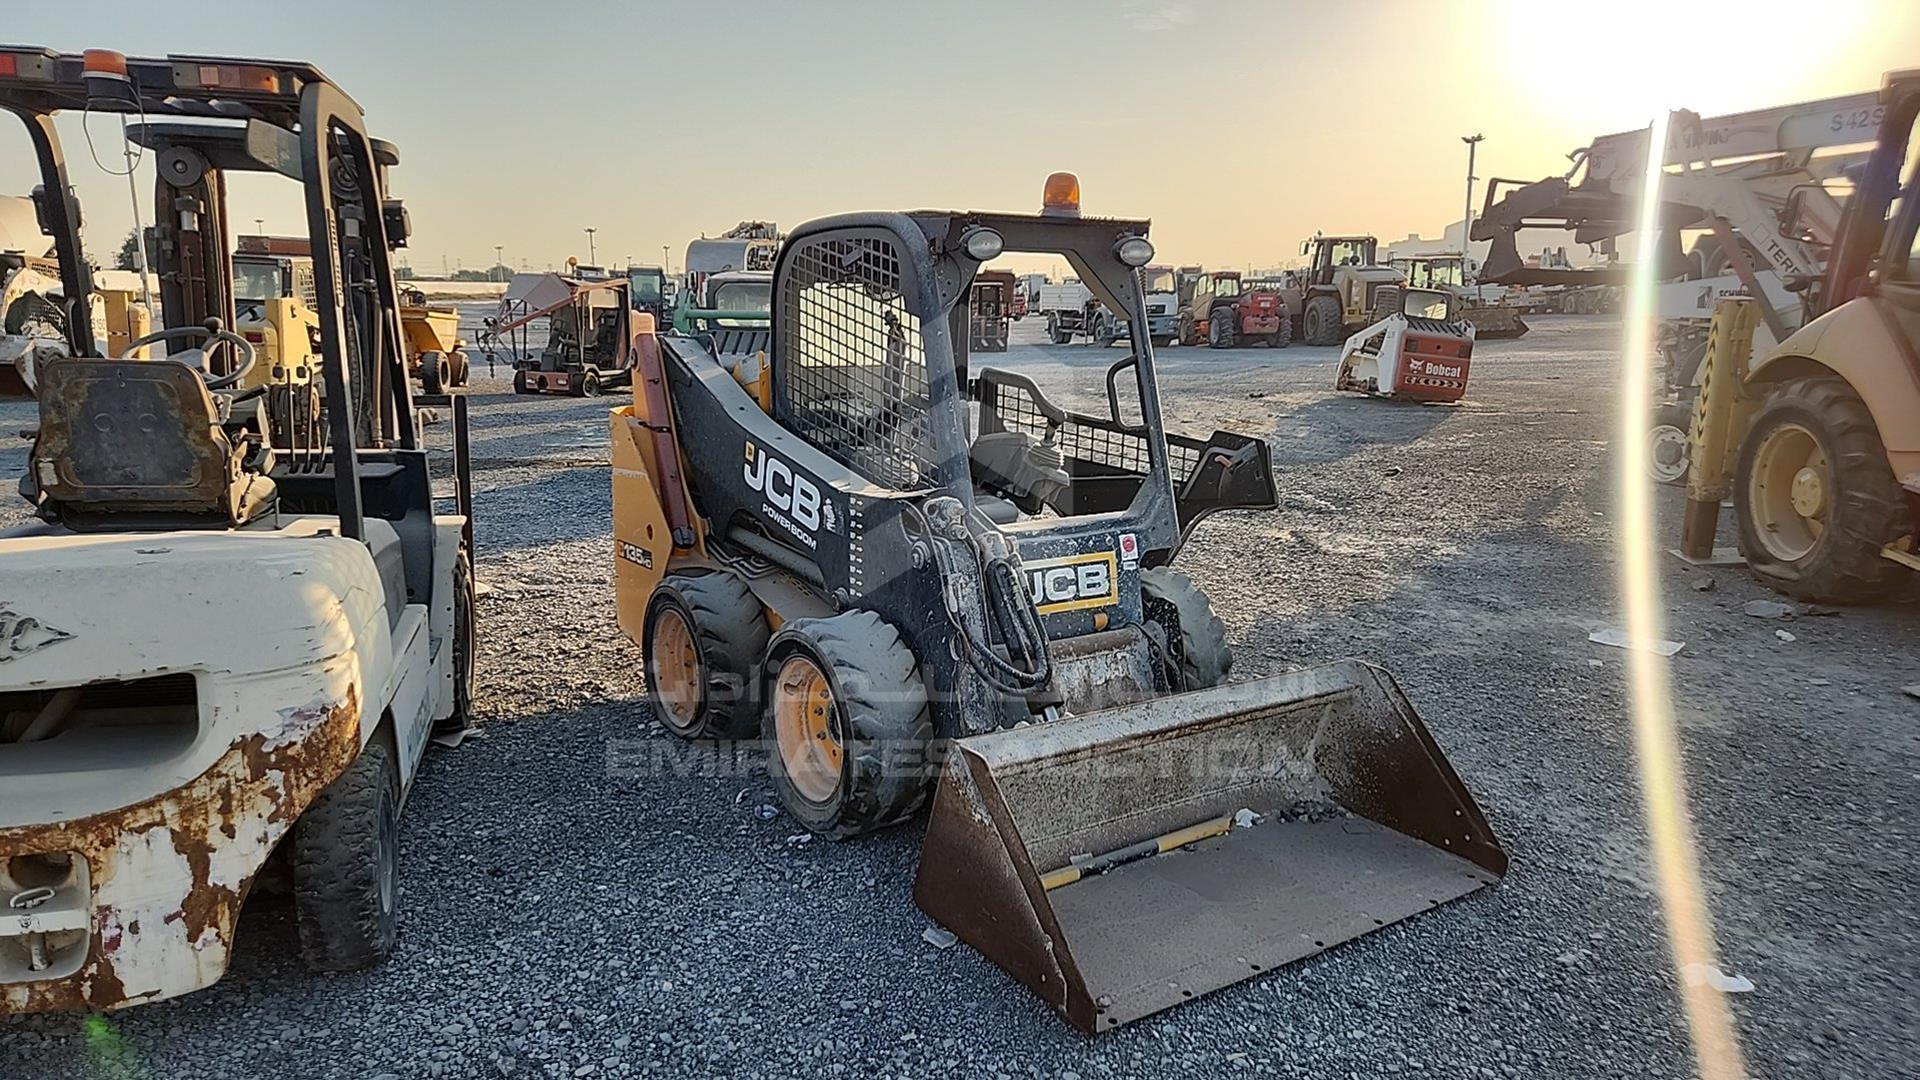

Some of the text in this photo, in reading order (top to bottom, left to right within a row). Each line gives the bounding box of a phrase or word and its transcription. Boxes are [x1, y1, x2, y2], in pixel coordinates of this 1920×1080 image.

[1425, 362, 1462, 378] Bobcat
[743, 448, 822, 532] JCB
[1031, 563, 1110, 605] JCB
